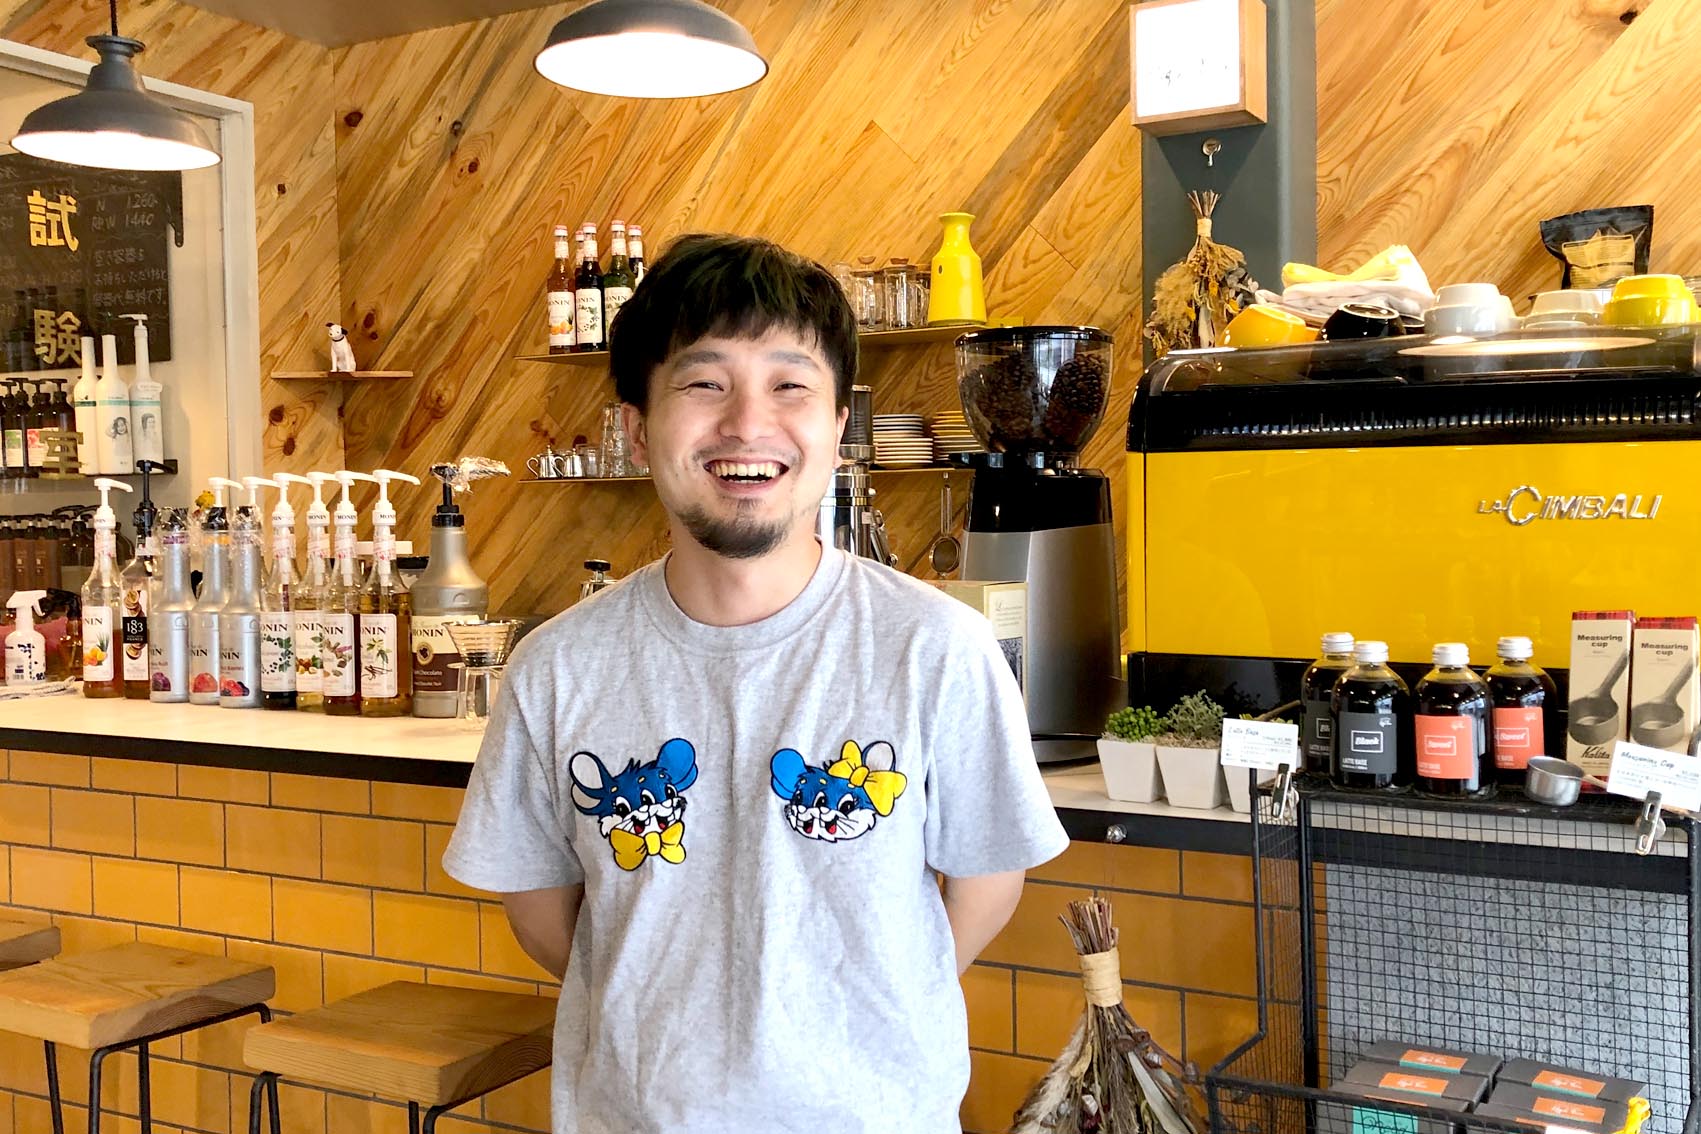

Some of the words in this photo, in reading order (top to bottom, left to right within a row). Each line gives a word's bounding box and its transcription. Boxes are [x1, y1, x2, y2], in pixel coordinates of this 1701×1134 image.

[1477, 500, 1507, 514] LA
[1506, 485, 1664, 526] CIMBALI
[84, 617, 103, 625] NIN
[261, 623, 288, 632] ONIN
[295, 622, 324, 631] ONIN
[324, 626, 344, 635] NIN
[361, 626, 387, 635] ONIN
[1577, 634, 1623, 643] Measuring
[1641, 642, 1689, 651] Measuring
